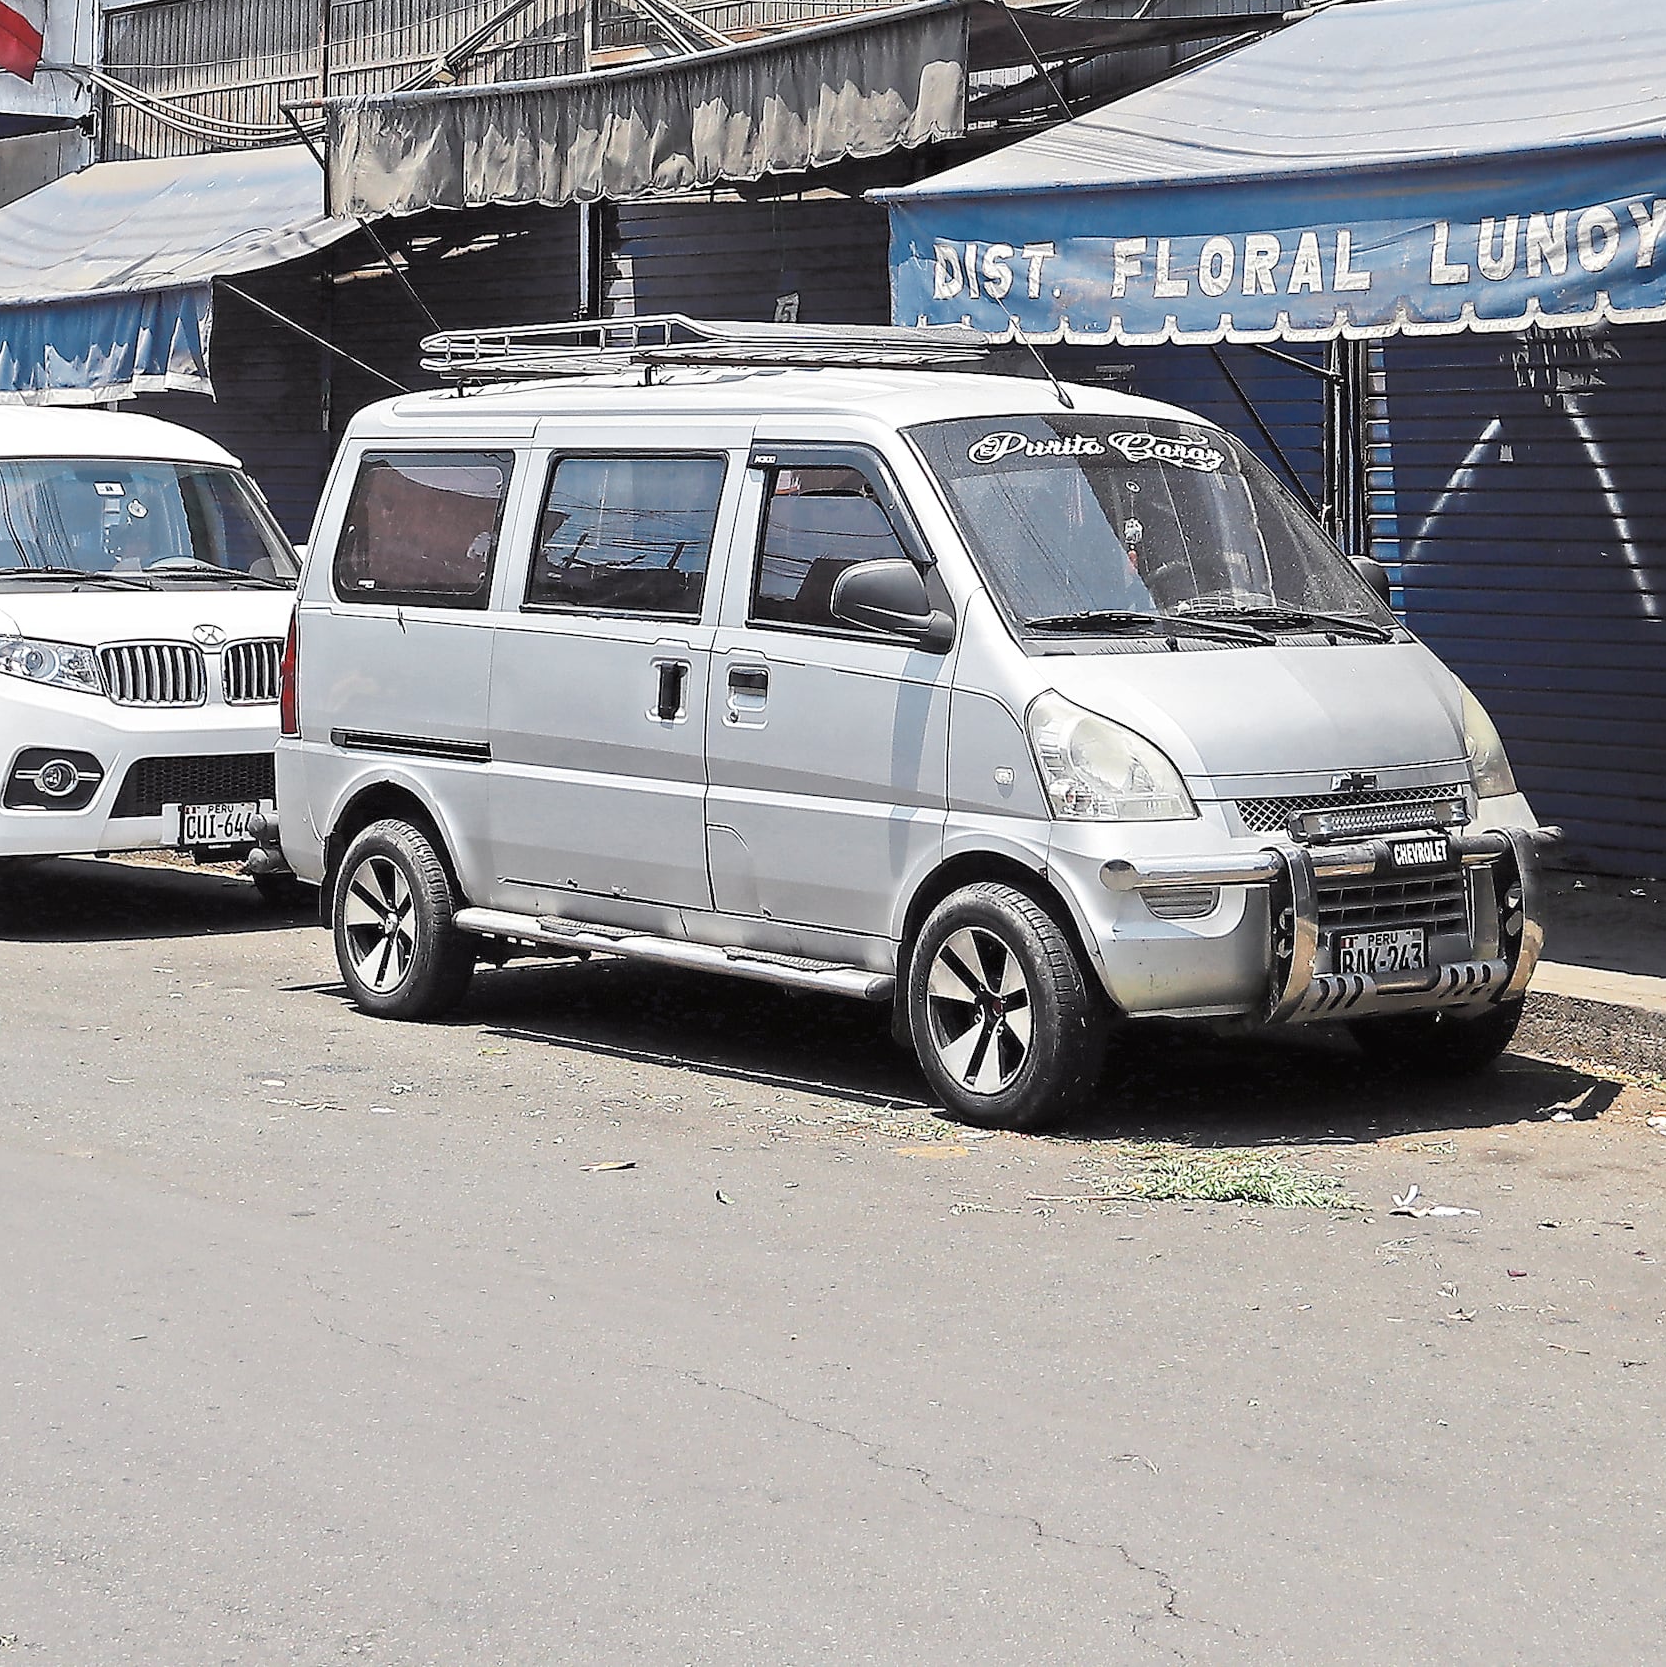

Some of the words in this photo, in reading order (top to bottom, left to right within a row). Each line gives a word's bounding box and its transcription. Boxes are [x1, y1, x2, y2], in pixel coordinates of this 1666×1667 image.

[932, 240, 1062, 299] DIST.
[1110, 228, 1372, 298] FLORAL
[208, 804, 234, 814] PERU
[1393, 839, 1447, 866] CHEVROLET
[1368, 932, 1399, 946] PERU
